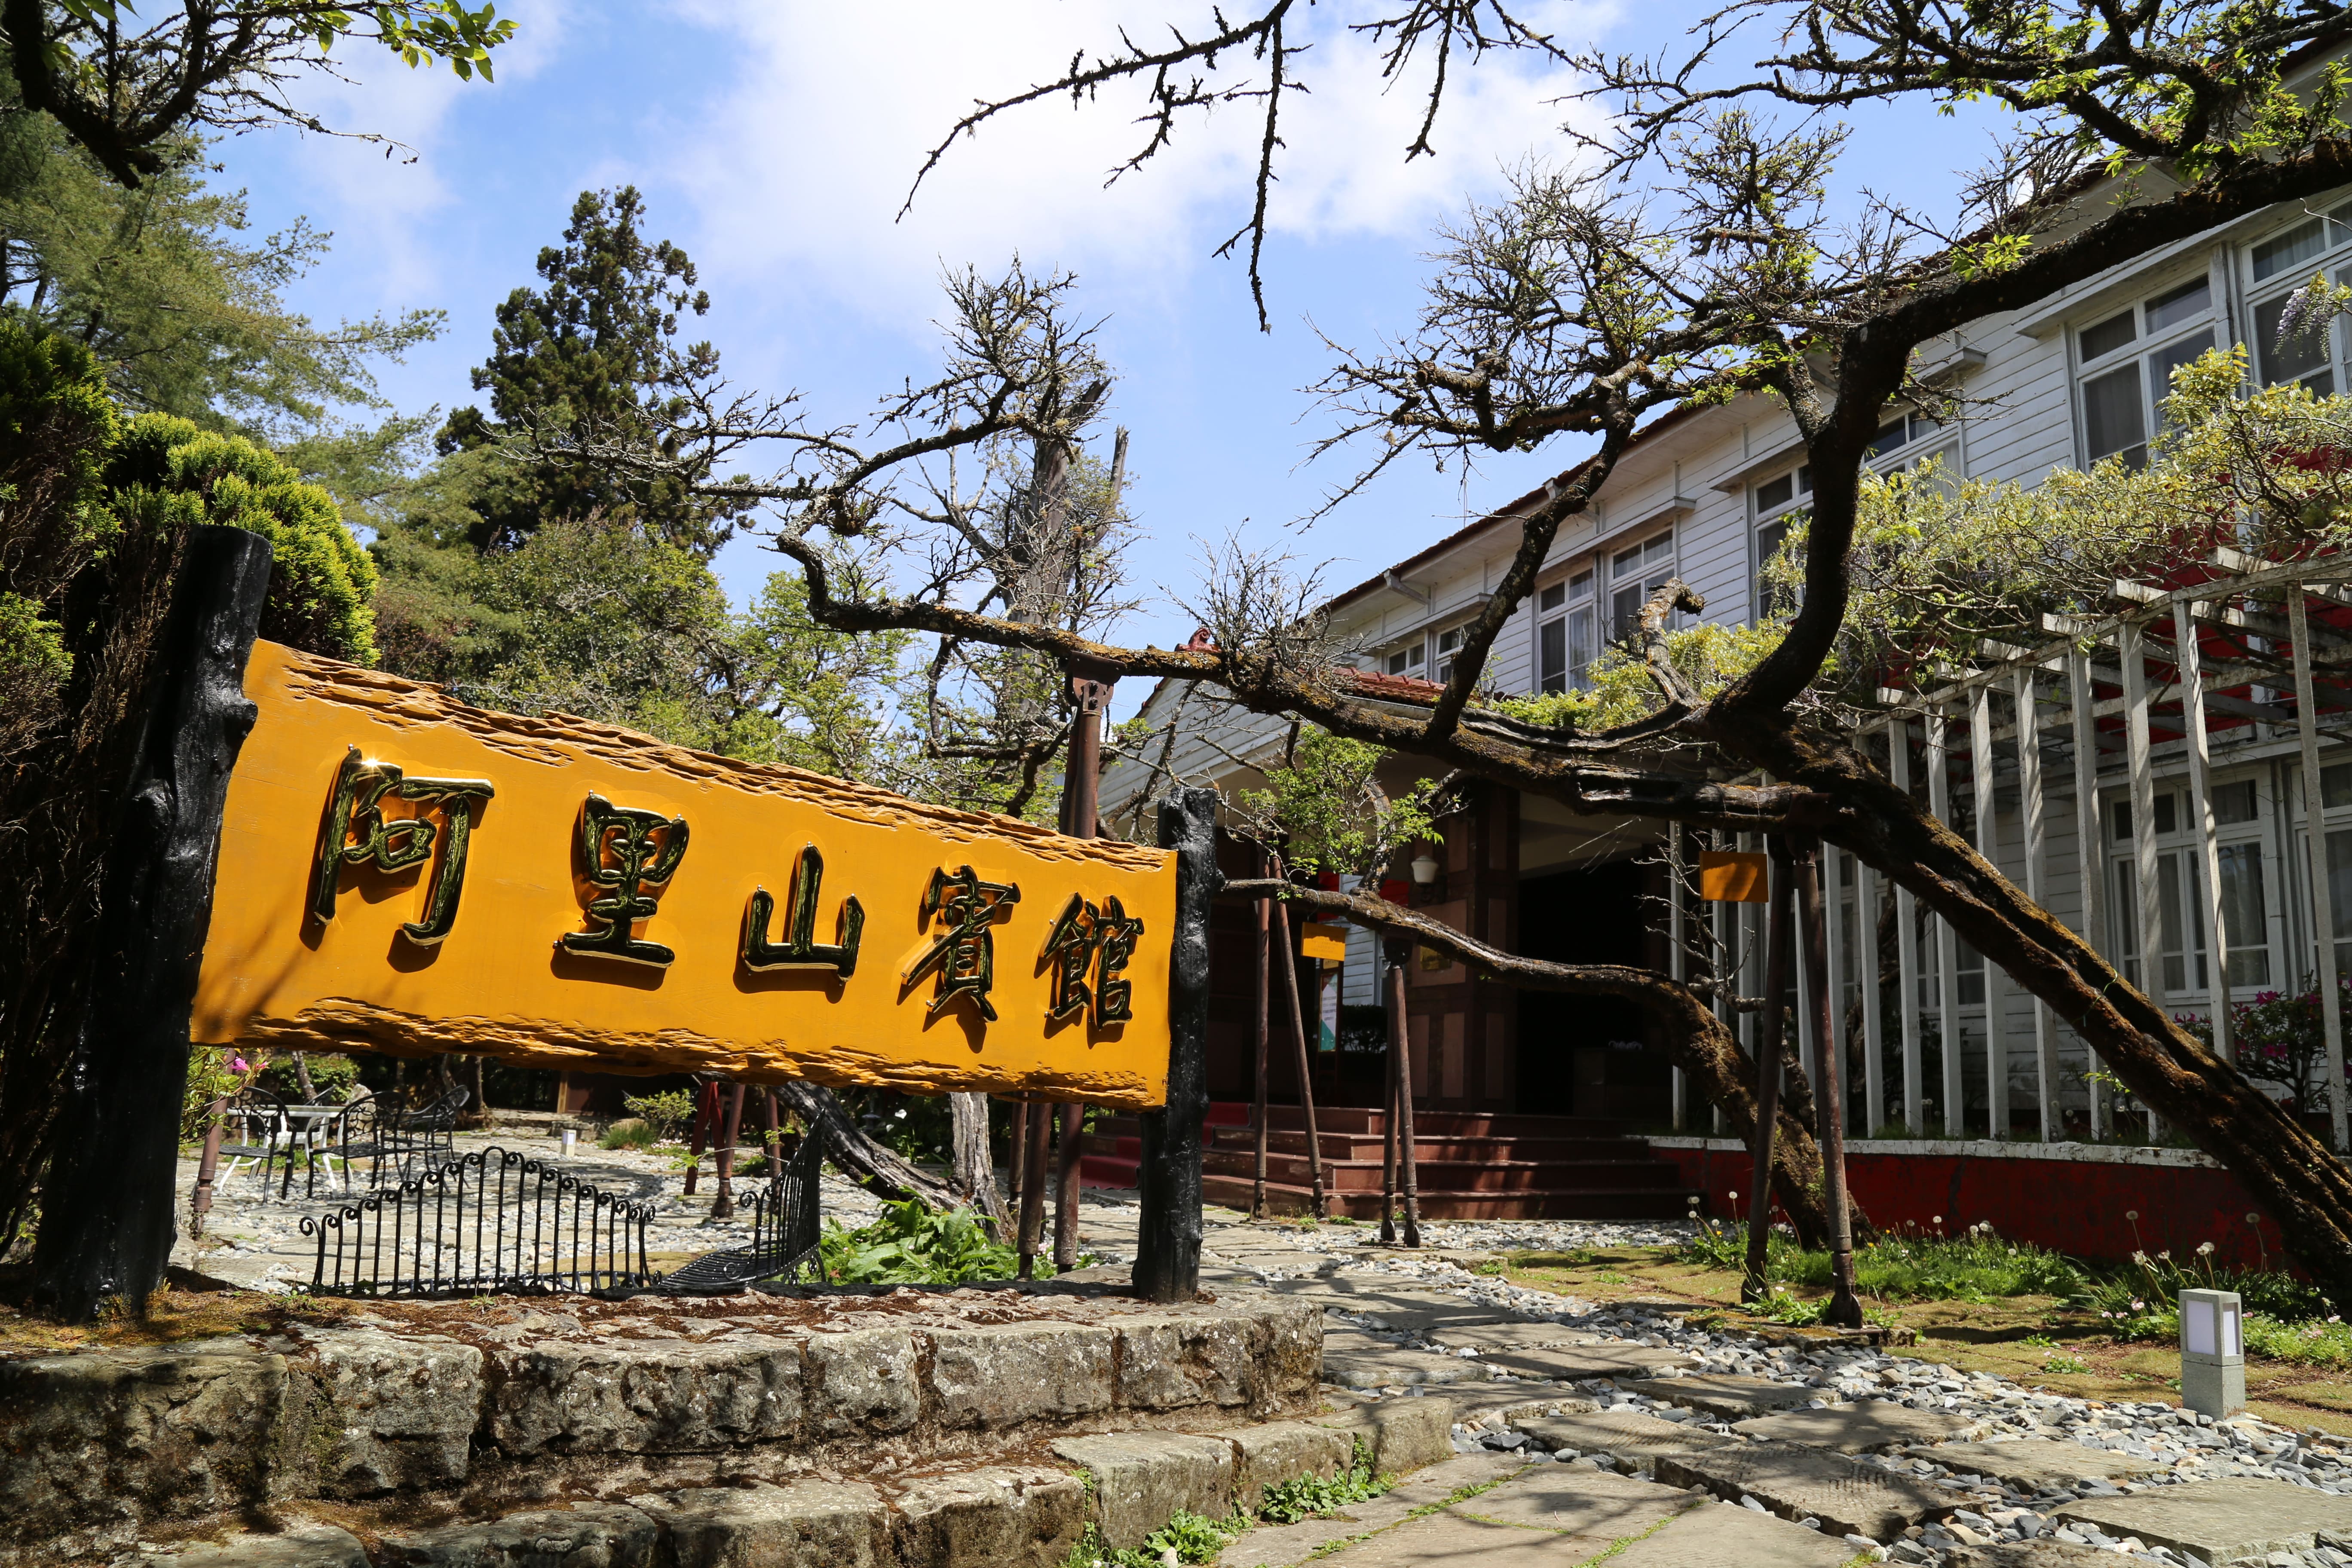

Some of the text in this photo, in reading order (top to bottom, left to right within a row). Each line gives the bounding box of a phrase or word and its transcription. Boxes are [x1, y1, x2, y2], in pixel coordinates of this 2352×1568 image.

[314, 747, 1144, 1031] 阿里山賓館
